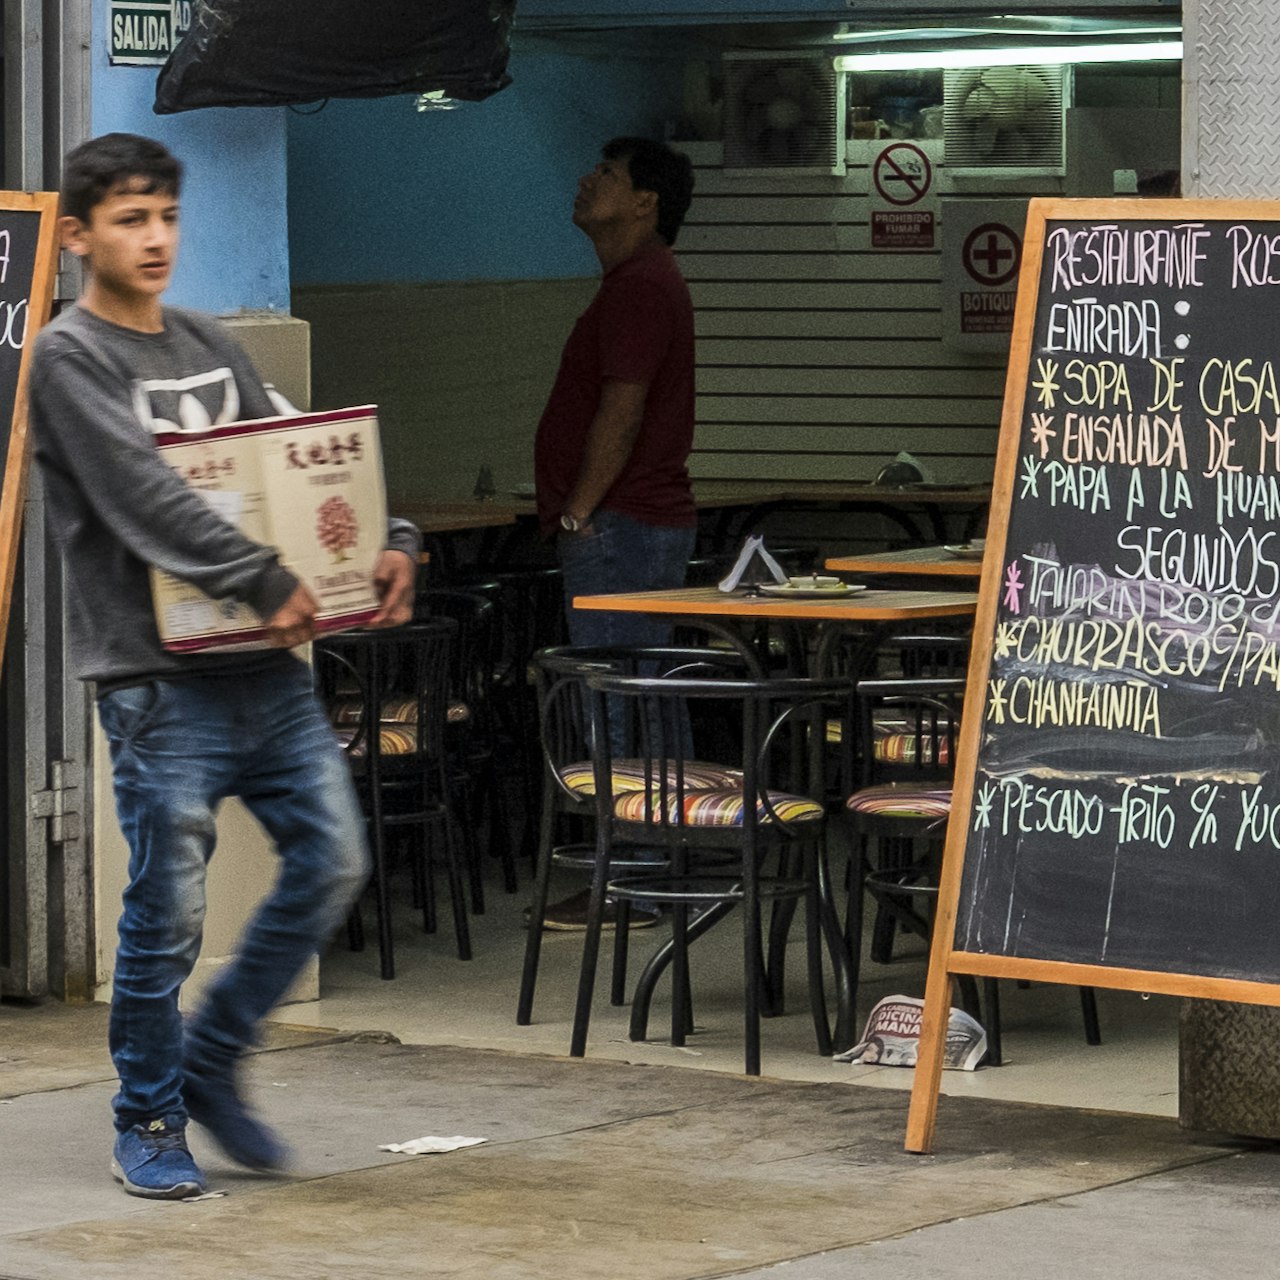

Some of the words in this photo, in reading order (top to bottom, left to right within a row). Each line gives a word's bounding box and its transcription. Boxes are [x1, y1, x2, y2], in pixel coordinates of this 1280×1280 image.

[113, 13, 169, 51] SALIDA
[875, 213, 931, 224] PROHIBIDO
[885, 224, 920, 234] FUMAR
[1047, 222, 1212, 292] RESTAURANTE
[1147, 357, 1185, 413] DE
[1199, 357, 1280, 417] CASA
[1203, 415, 1243, 479] DE
[1127, 466, 1144, 522] A
[1160, 467, 1193, 518] LA
